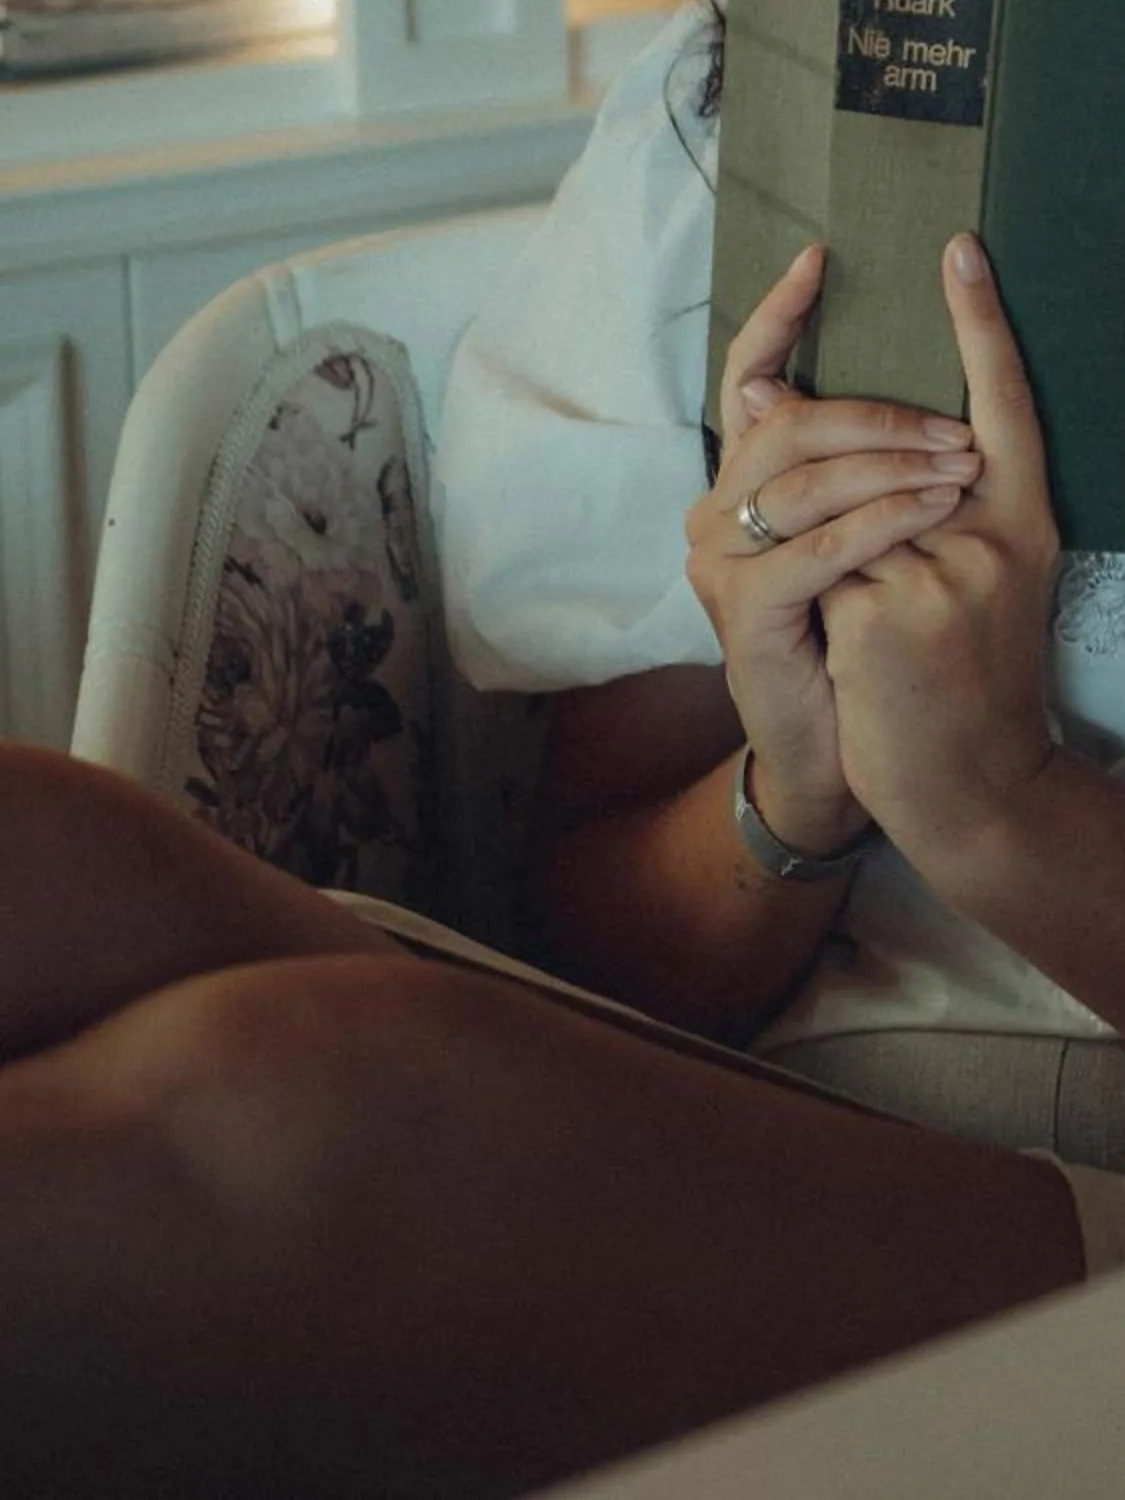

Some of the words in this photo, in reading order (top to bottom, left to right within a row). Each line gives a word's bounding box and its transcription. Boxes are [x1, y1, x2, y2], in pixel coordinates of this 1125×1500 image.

[848, 24, 892, 61] Nie
[902, 37, 976, 69] mehr
[884, 64, 937, 93] arm
